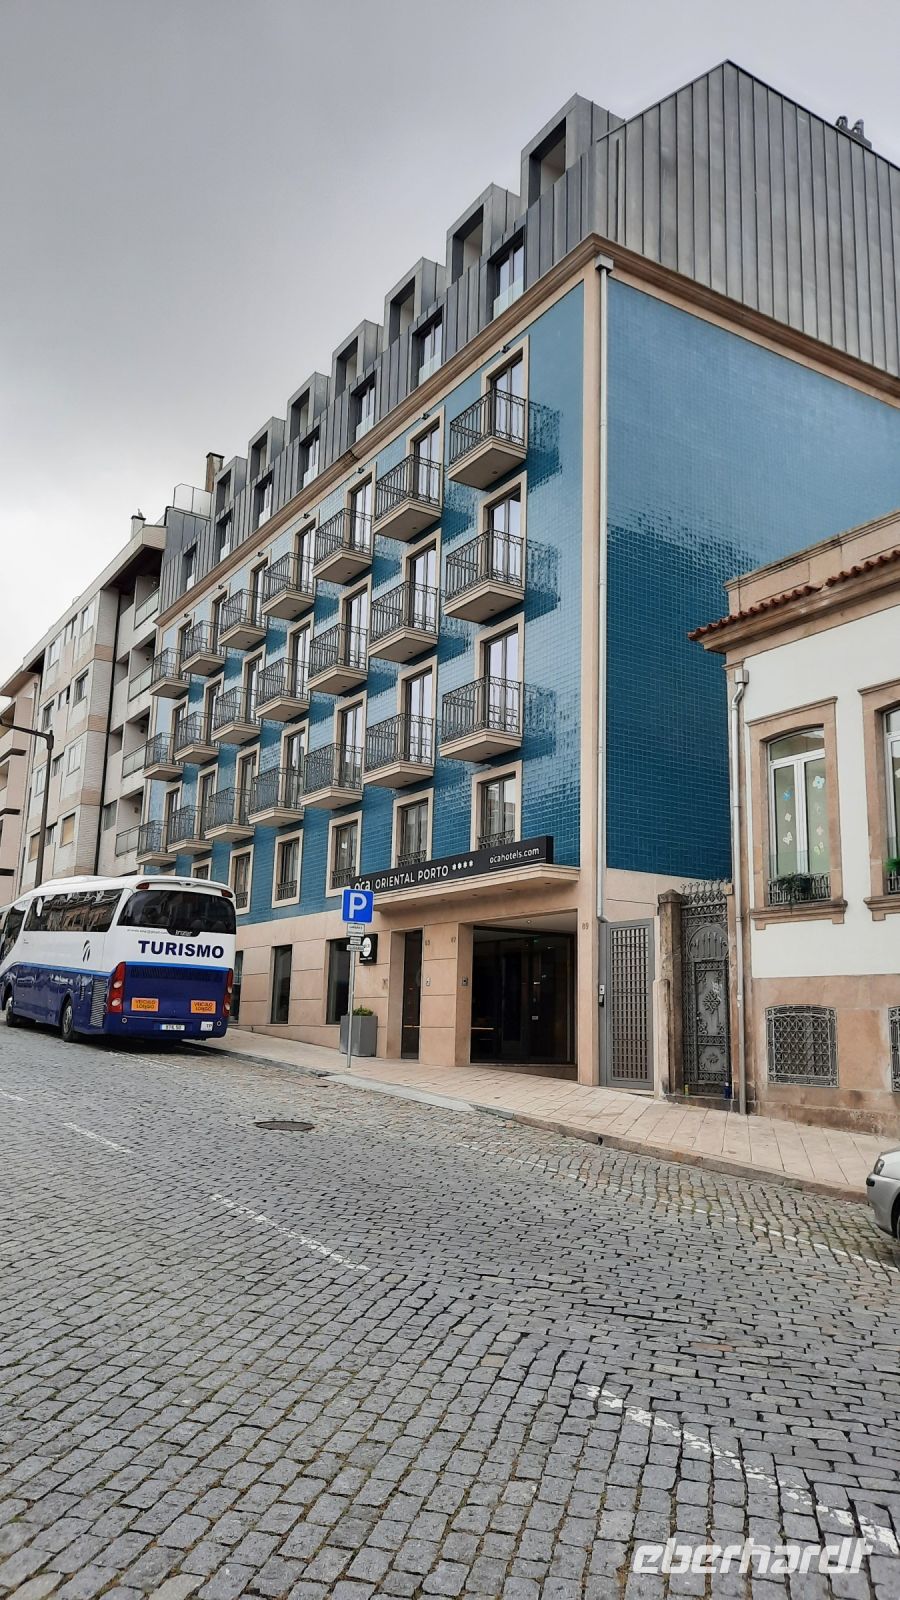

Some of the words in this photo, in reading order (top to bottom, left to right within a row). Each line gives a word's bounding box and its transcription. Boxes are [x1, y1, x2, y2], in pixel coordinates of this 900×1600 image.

[375, 871, 415, 890] ORIENTAL
[417, 865, 449, 881] PORTO
[349, 892, 367, 919] P
[137, 940, 225, 959] TURISMO
